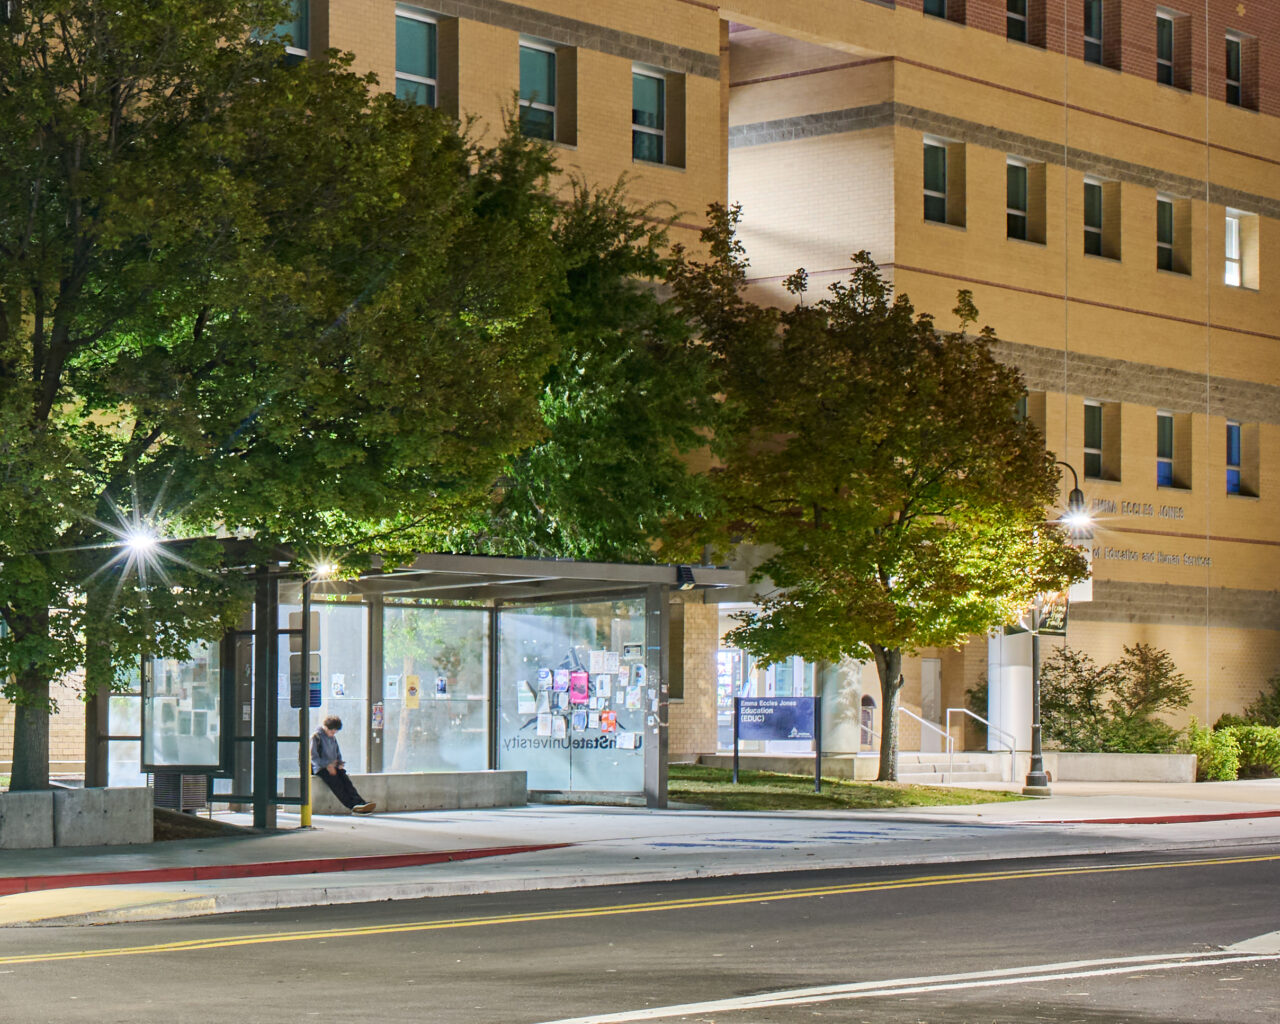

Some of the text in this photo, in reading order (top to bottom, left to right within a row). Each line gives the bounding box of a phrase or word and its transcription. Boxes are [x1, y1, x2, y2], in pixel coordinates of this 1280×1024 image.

[1121, 501, 1154, 517] ECCLES
[1158, 505, 1185, 521] JONES
[1104, 547, 1138, 561] Education
[1142, 551, 1156, 563] and
[1157, 551, 1180, 565] Human
[1183, 553, 1213, 568] Services
[740, 707, 774, 715] Education
[740, 715, 765, 723] (EDUC)
